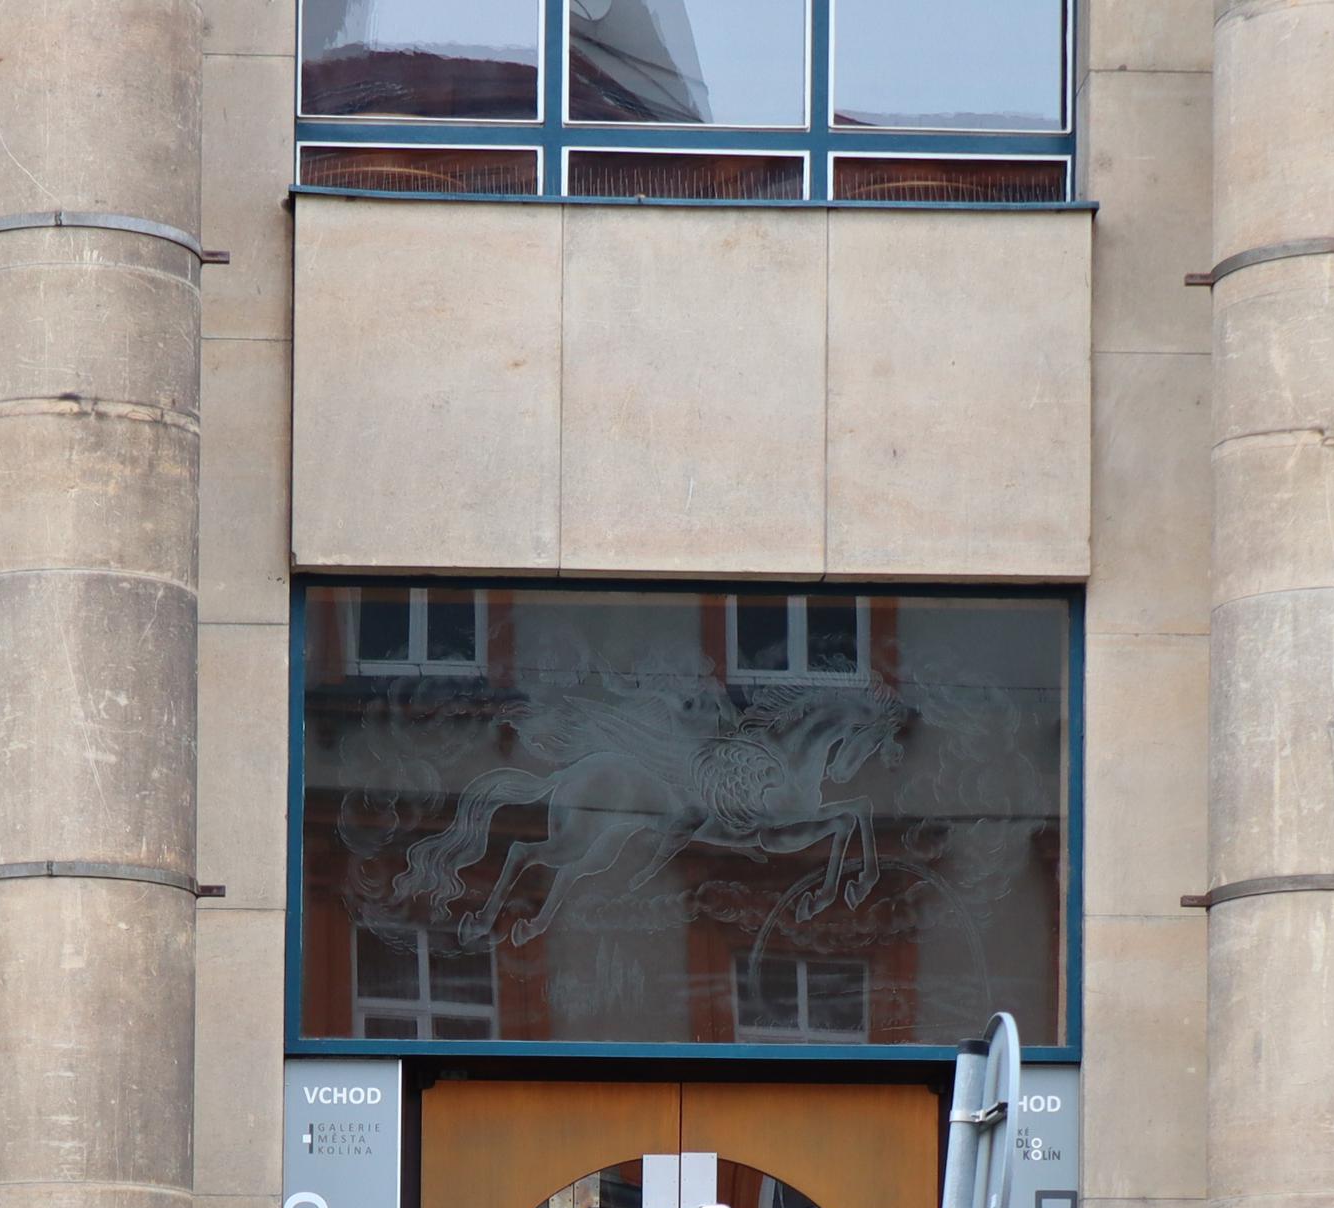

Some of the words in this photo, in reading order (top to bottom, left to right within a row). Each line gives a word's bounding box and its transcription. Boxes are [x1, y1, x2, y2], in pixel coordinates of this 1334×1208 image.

[303, 1086, 382, 1105] VCHOD
[1018, 1095, 1061, 1113] HOD
[318, 1123, 381, 1132] GALERIE
[318, 1133, 366, 1143] MĚSTA
[318, 1145, 373, 1155] KOLÍNA
[1022, 1147, 1061, 1161] KOLÍN
